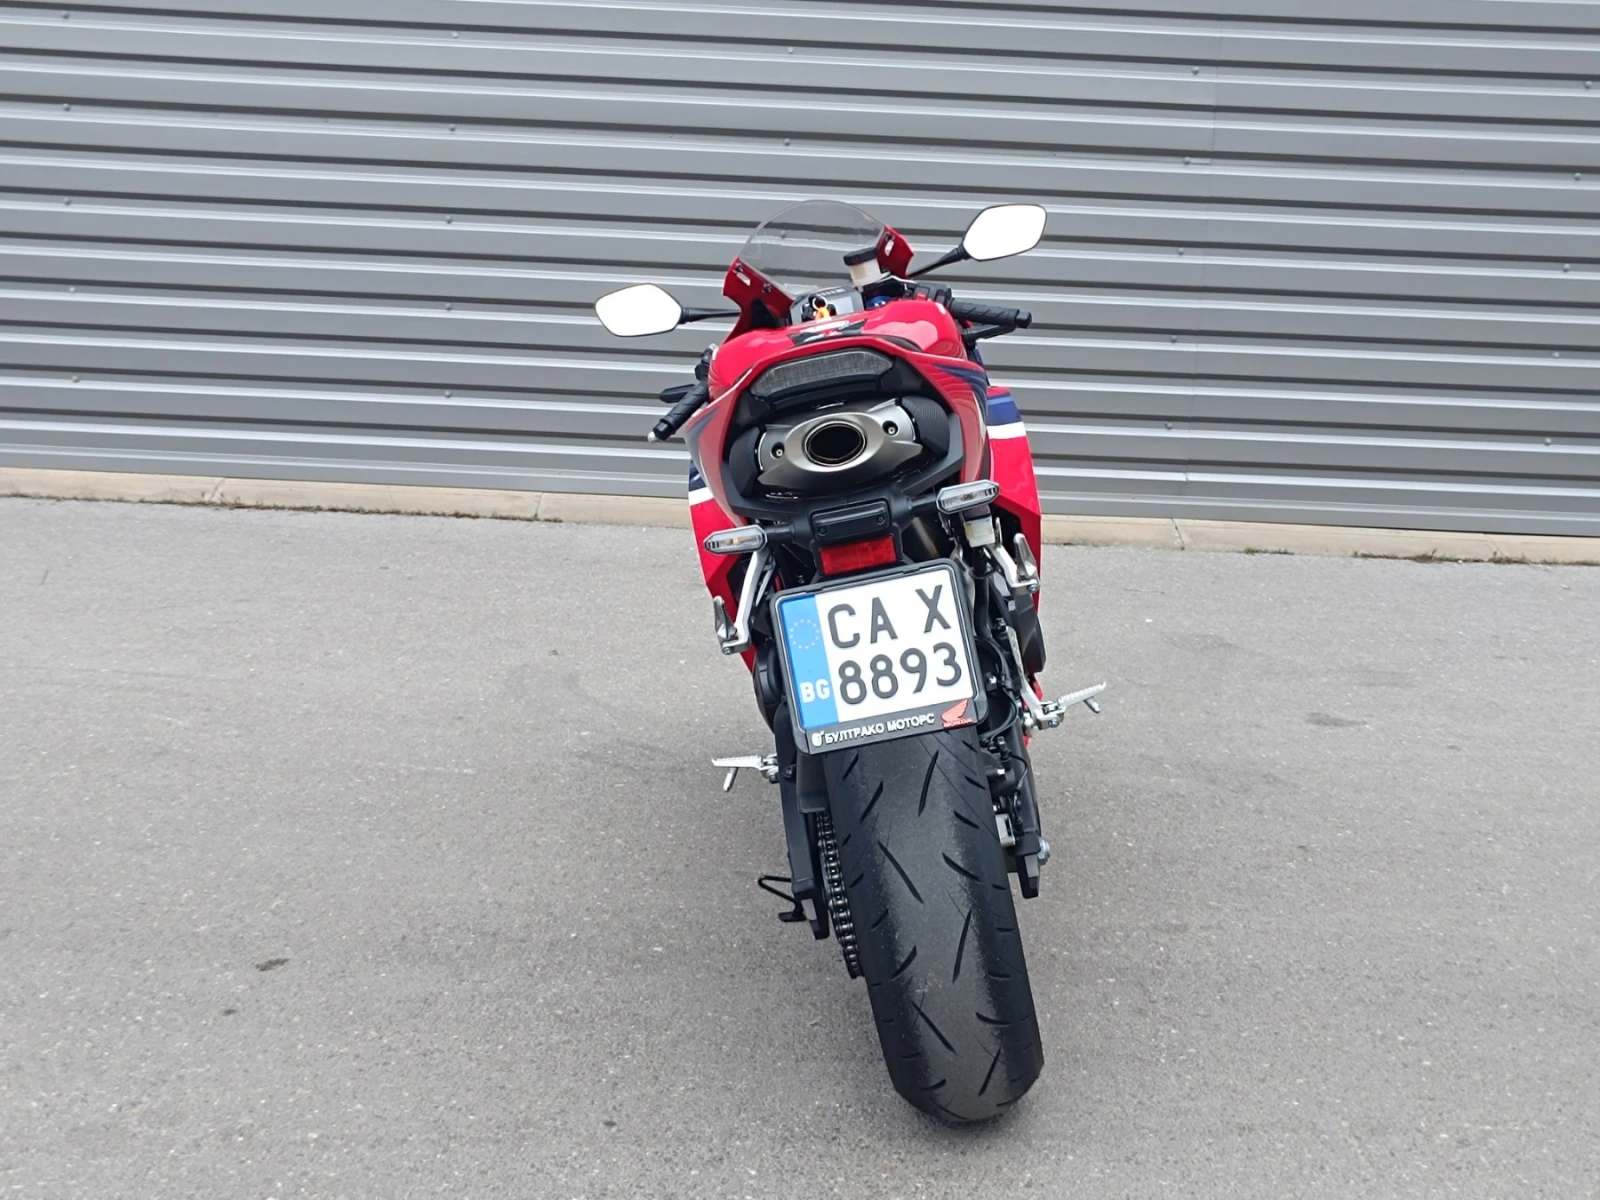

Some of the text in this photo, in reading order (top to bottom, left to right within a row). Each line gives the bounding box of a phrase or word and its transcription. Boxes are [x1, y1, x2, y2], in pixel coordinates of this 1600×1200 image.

[838, 641, 962, 705] 8893
[799, 678, 831, 704] BG
[824, 713, 935, 744] БУЛТРАКО МОТОРС
